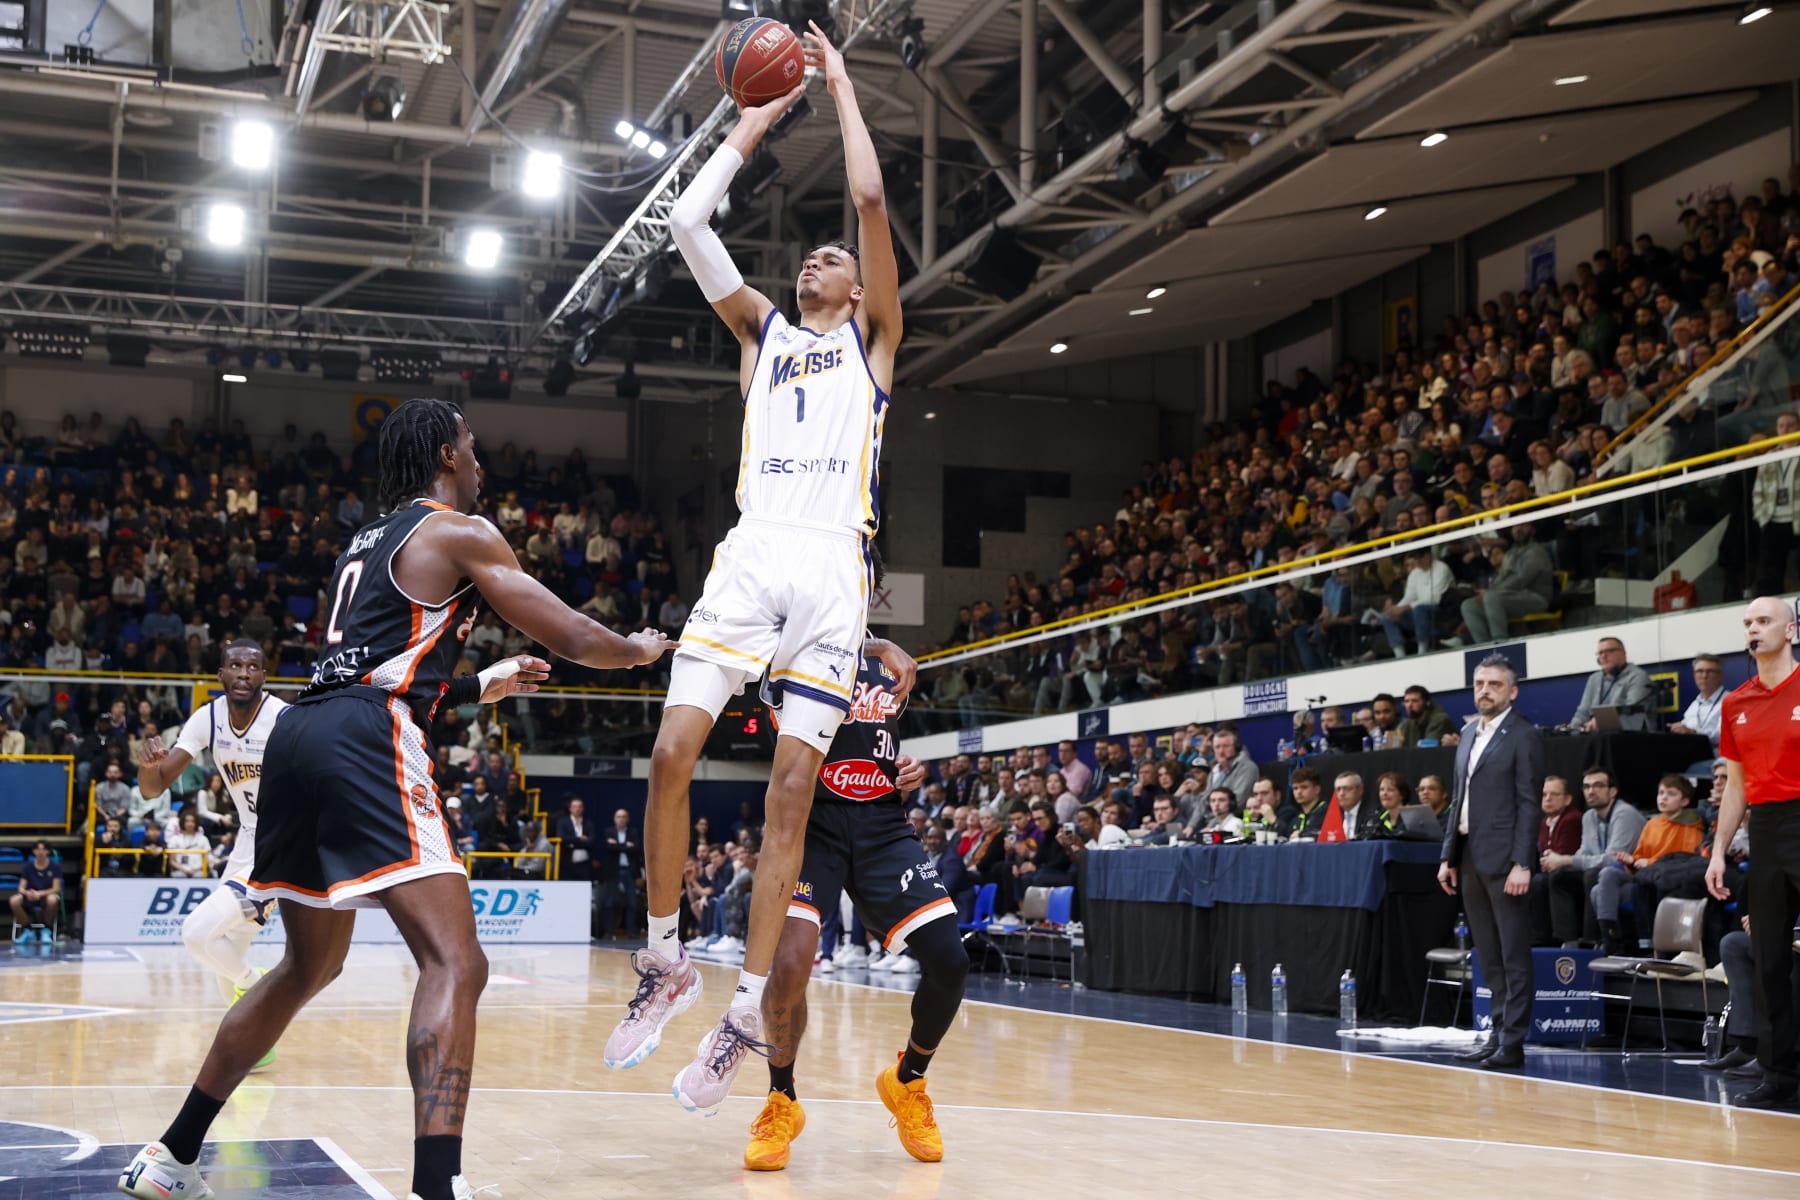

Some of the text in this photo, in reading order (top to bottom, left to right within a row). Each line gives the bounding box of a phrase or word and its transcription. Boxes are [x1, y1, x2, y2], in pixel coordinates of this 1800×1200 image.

[795, 387, 805, 423] 1
[327, 560, 364, 645] 0
[872, 729, 895, 761] 30
[223, 761, 262, 785] METS9
[823, 764, 894, 791] le Gaulo
[243, 790, 257, 813] 5
[147, 886, 212, 915] BB
[470, 888, 520, 916] SD
[477, 918, 524, 926] ANCOURT
[1535, 989, 1566, 998] Honda
